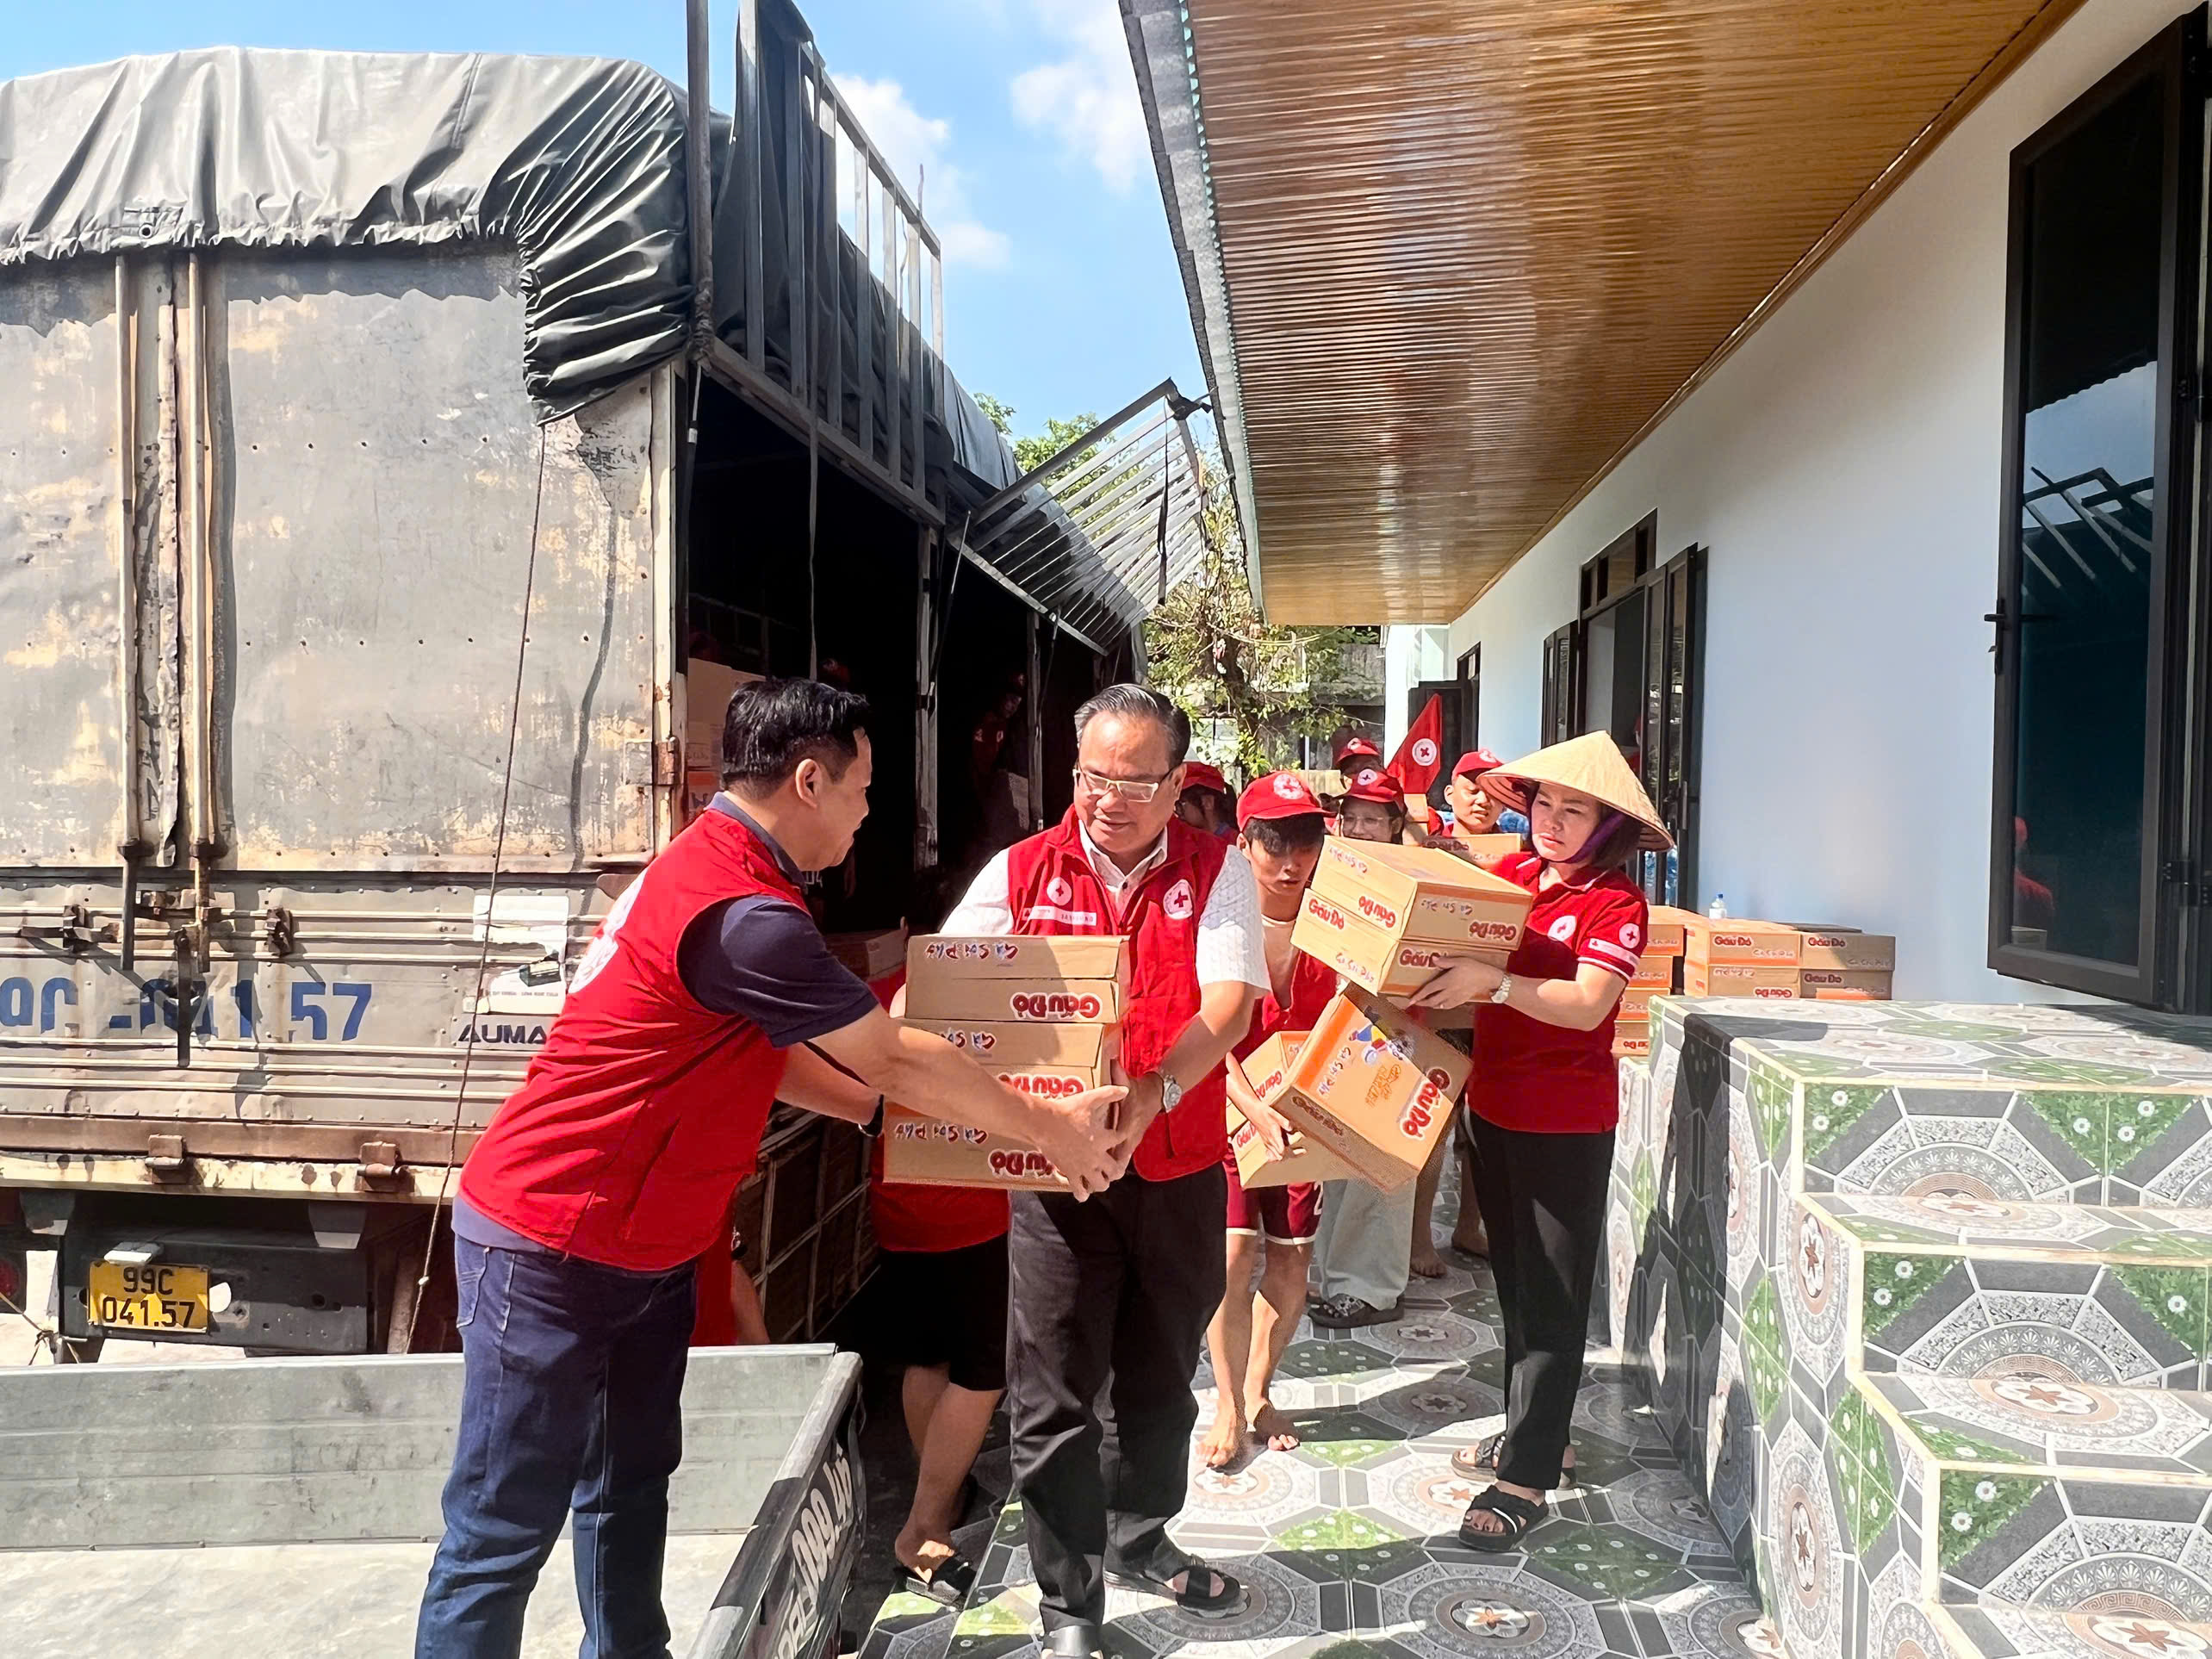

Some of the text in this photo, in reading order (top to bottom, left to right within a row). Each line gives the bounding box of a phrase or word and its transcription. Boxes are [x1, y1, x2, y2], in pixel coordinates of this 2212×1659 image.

[1012, 994, 1101, 1018] Gấu Đỏ
[124, 1267, 173, 1295] 99C
[103, 1296, 195, 1327] 041.57
